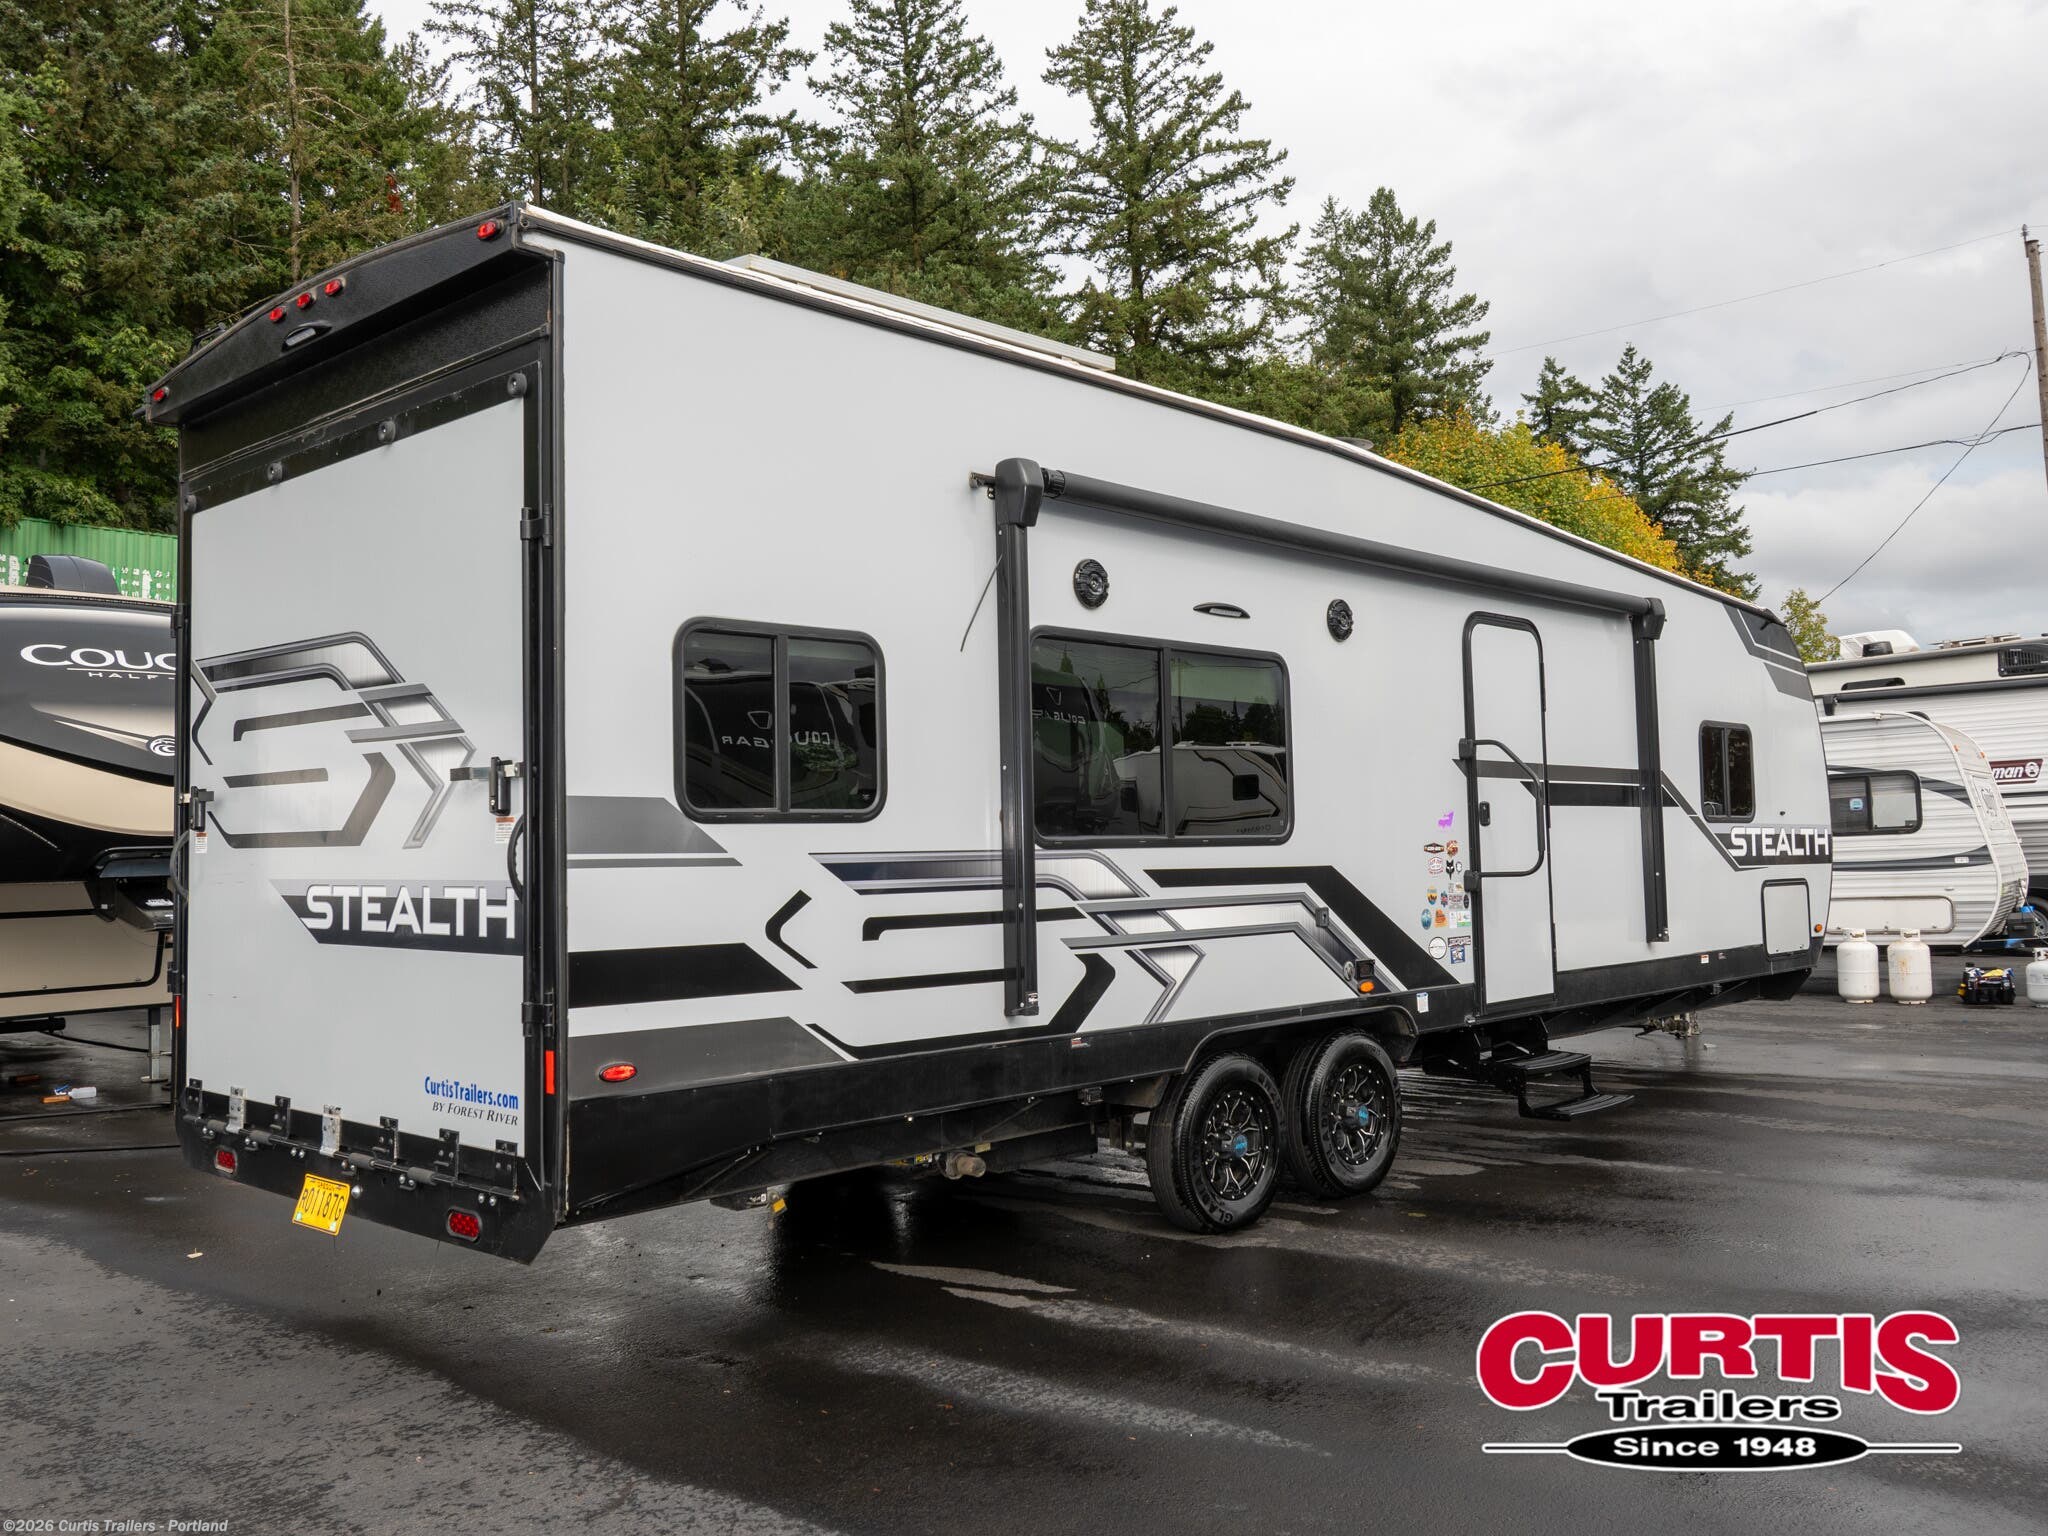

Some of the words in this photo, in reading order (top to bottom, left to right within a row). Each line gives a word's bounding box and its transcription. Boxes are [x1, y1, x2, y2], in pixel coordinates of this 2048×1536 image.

[1728, 827, 1830, 857] STEALTH
[301, 884, 516, 939] STEALTH
[424, 1076, 519, 1110] CurtisTrailers.com
[447, 1102, 485, 1120] FOREST
[486, 1109, 518, 1126] RIVER
